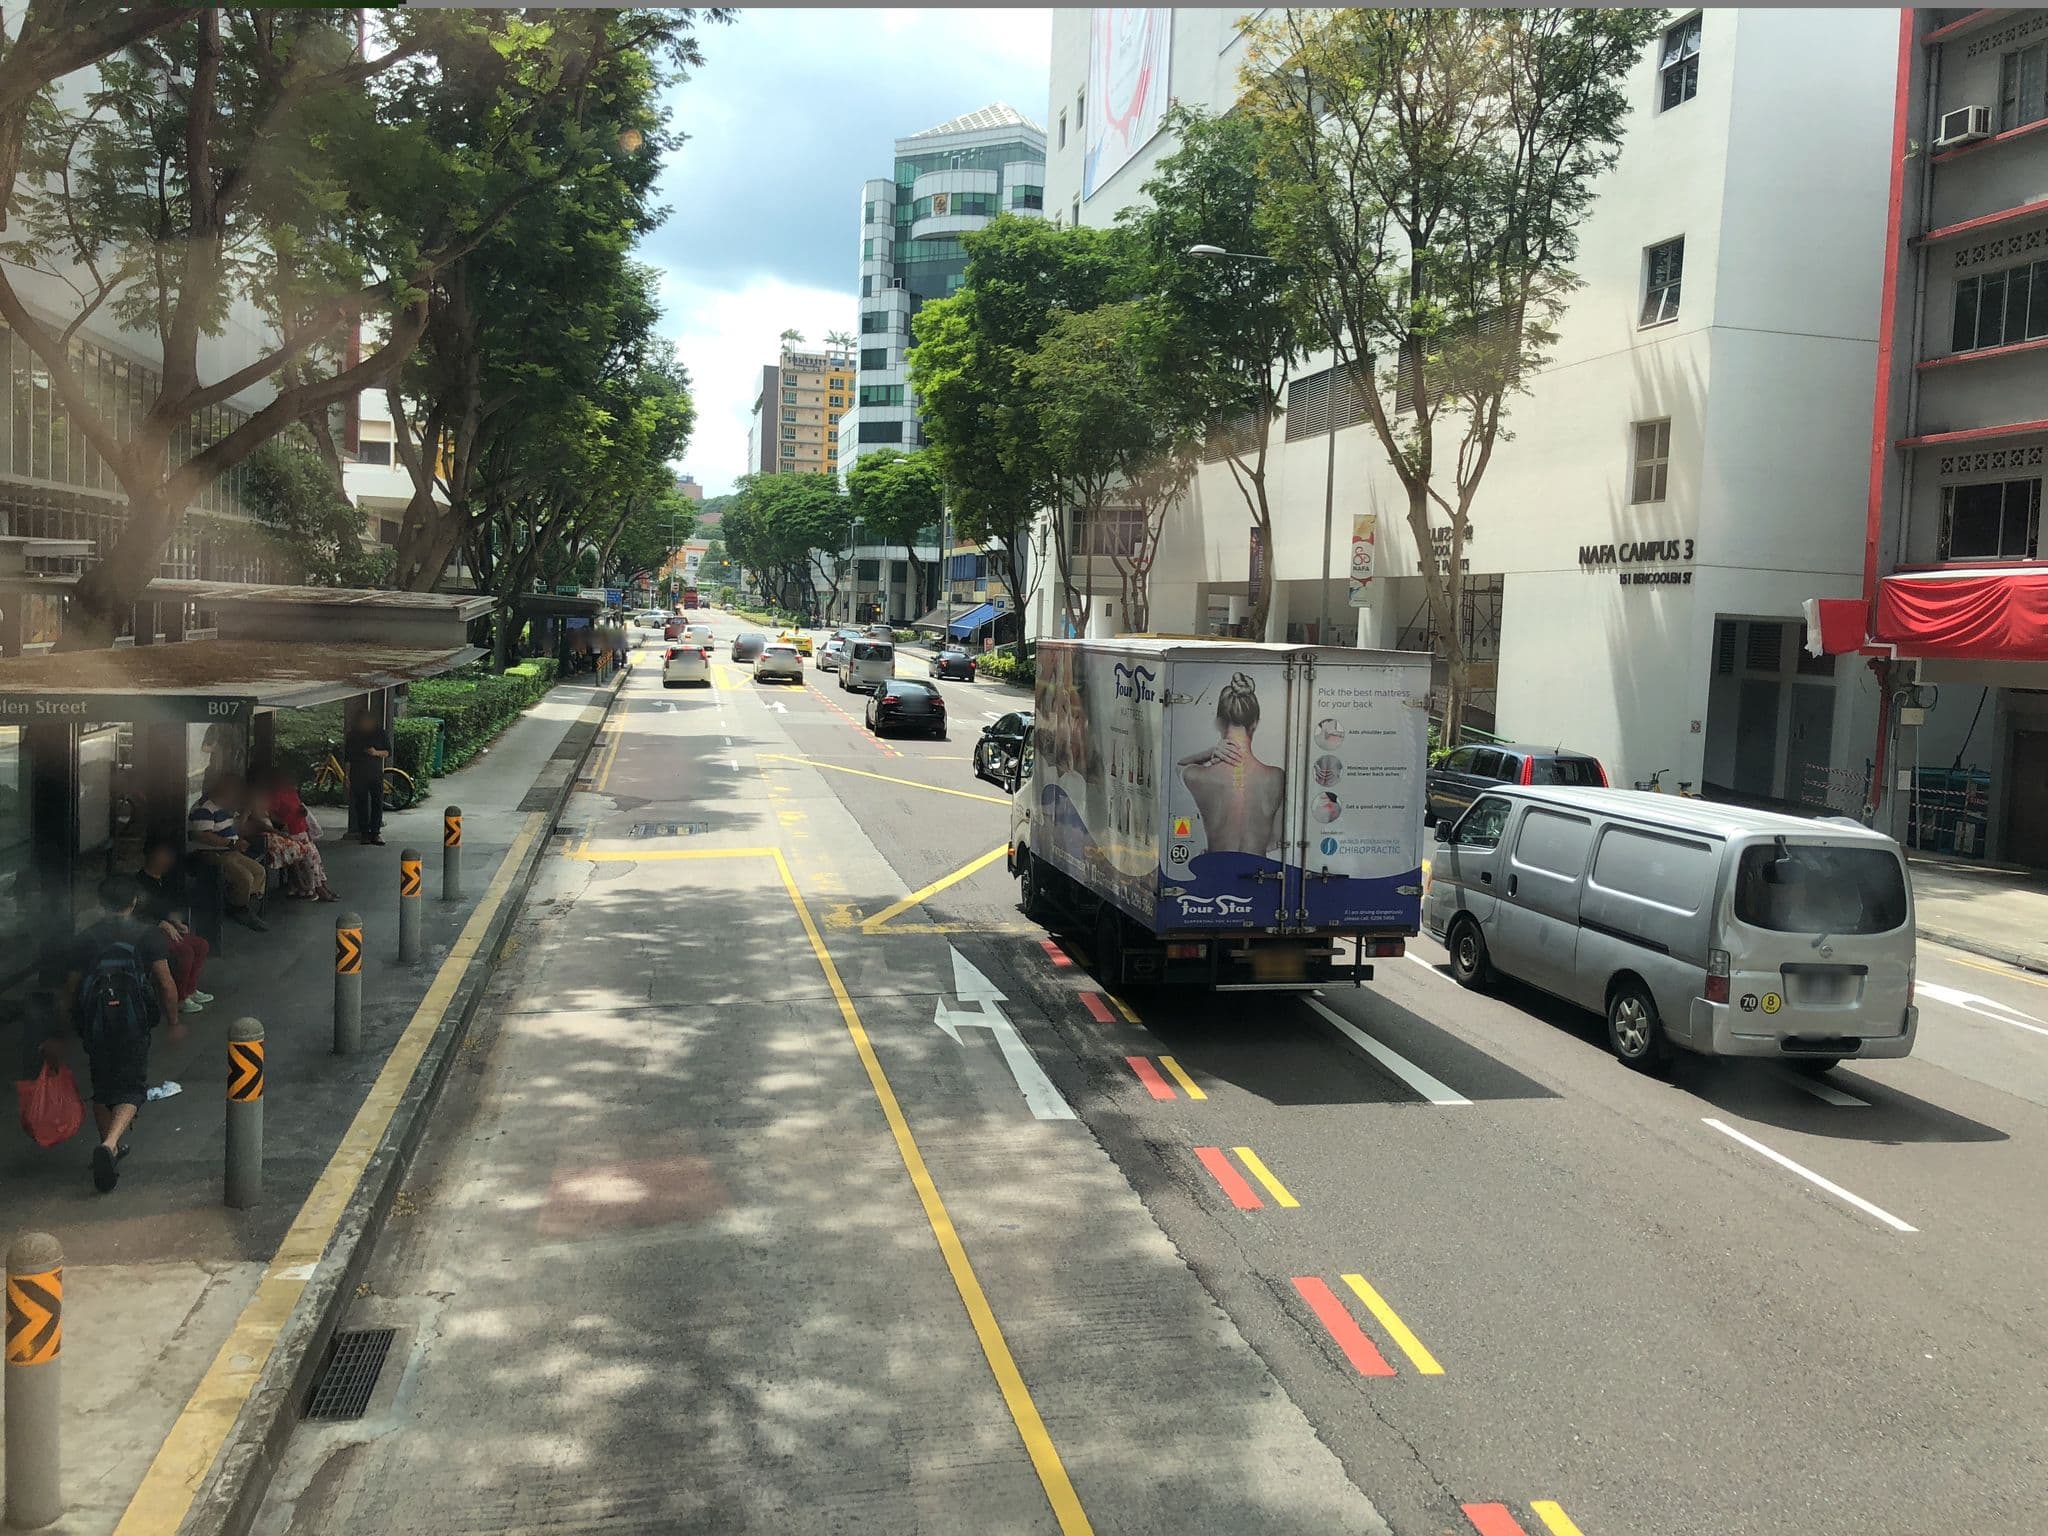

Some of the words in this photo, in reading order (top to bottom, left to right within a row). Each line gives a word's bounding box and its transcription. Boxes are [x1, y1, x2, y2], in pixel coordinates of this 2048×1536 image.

[1579, 545, 1617, 564] NAFA
[1619, 540, 1680, 562] CAMPUS
[1683, 539, 1694, 560] 3
[1633, 572, 1682, 584] BENCOOLEN
[1683, 572, 1693, 584] ST
[1318, 688, 1335, 697] Pick
[1337, 689, 1352, 697] the
[1353, 689, 1372, 697] best
[1374, 689, 1411, 698] mattress
[0, 699, 29, 714] len
[36, 700, 87, 714] Street
[208, 702, 240, 716] B07
[1318, 700, 1330, 708] for
[1331, 701, 1350, 710] your
[1353, 700, 1373, 709] back
[1172, 847, 1187, 858] 60
[1339, 846, 1401, 854] CHIROPRACTIC
[1743, 997, 1757, 1007] 70
[1767, 996, 1775, 1006] 8
